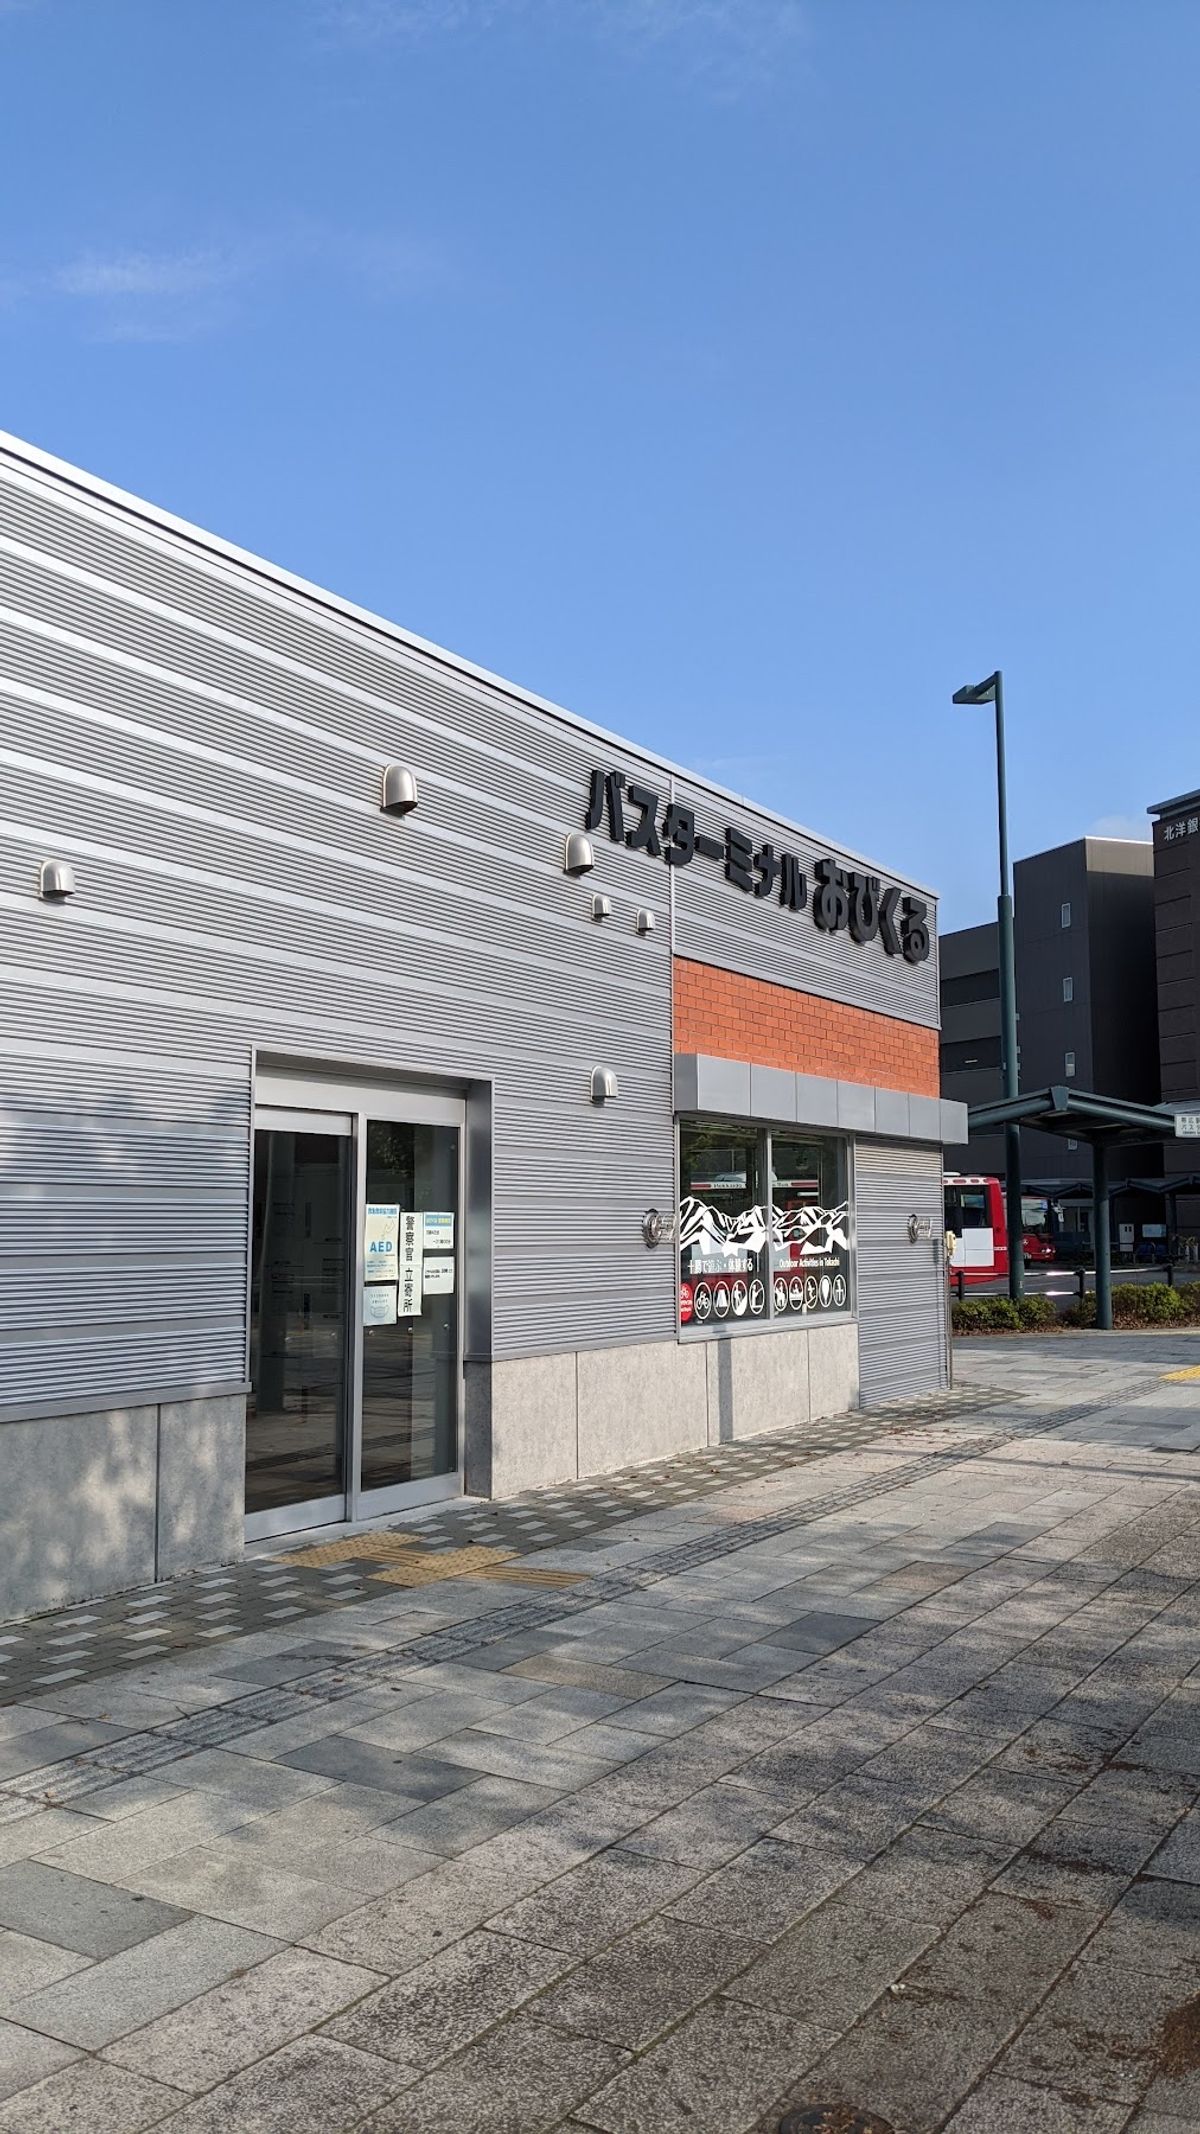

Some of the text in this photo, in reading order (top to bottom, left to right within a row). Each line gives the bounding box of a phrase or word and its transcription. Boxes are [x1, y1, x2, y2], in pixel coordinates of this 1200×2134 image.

[1164, 817, 1199, 841] 北洋銀
[585, 769, 930, 964] バスターミナル おびくる
[369, 1241, 393, 1253] AED
